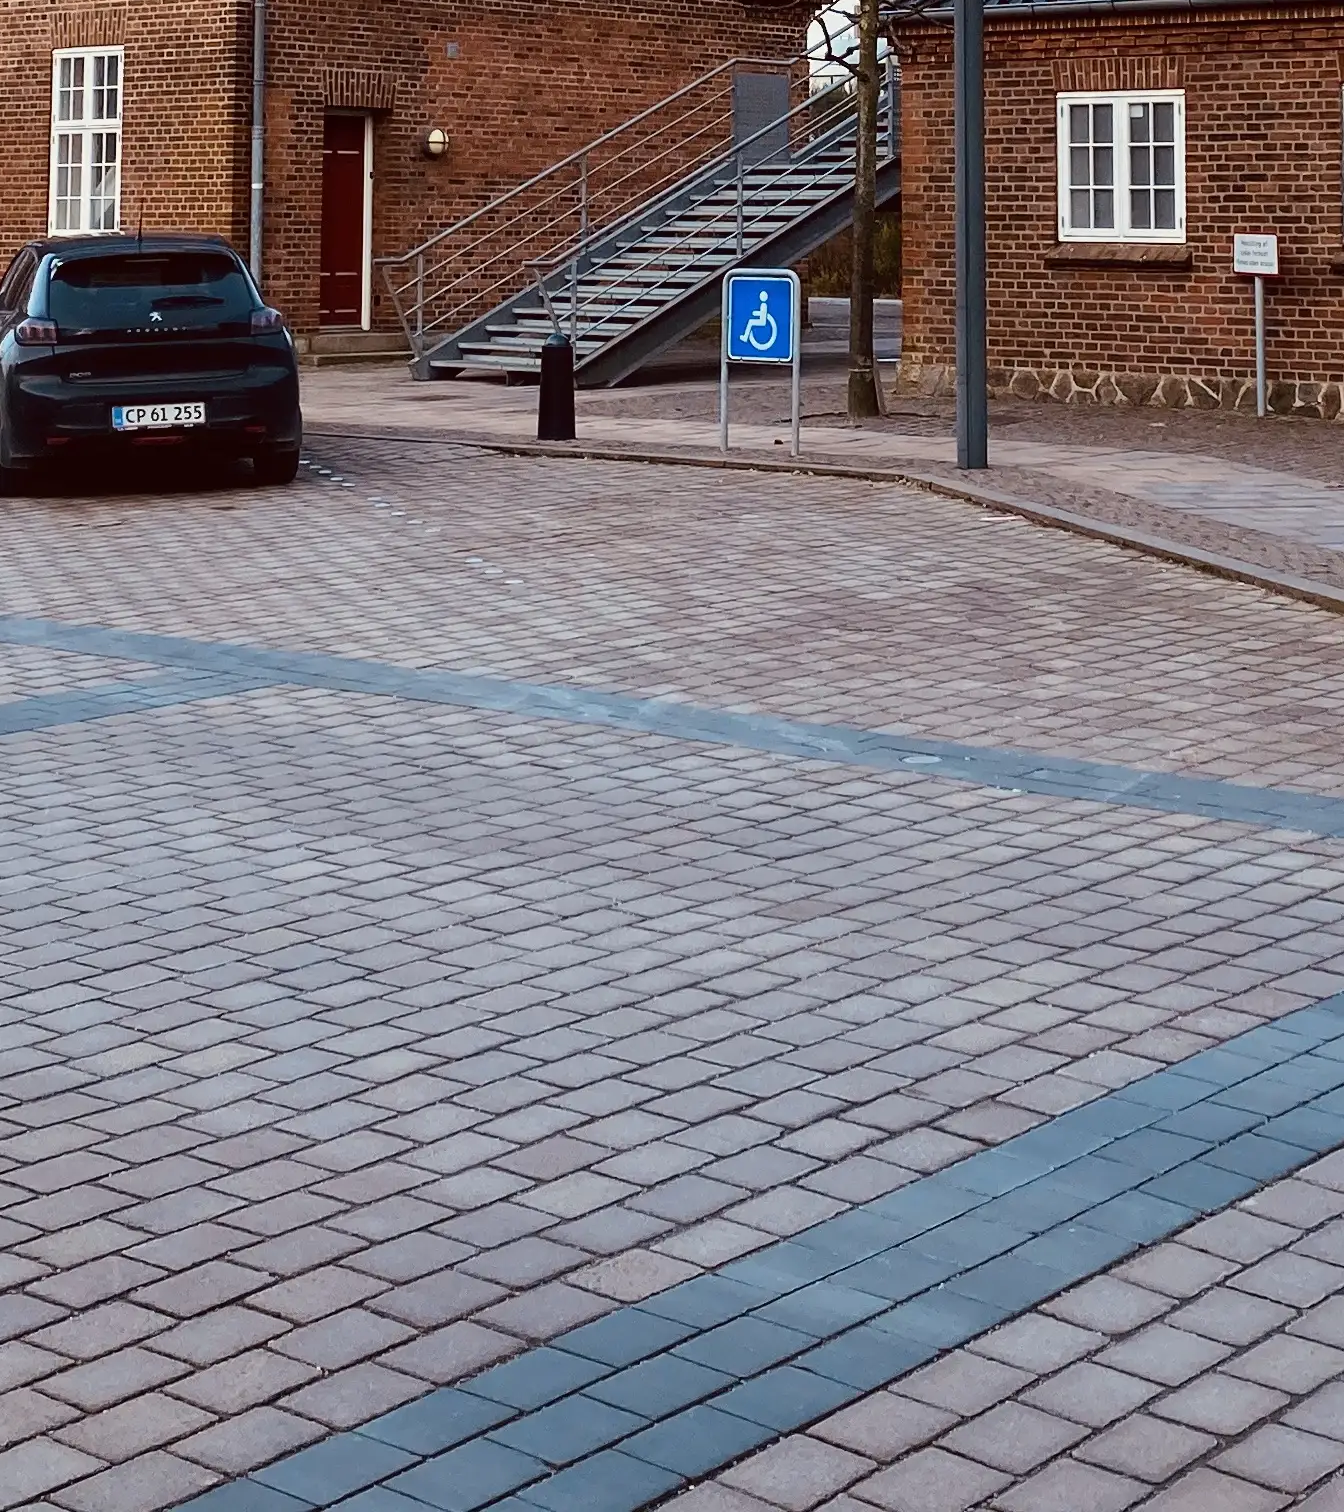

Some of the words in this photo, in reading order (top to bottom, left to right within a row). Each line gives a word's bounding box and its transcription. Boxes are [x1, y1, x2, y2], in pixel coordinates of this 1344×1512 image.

[126, 409, 146, 423] CP
[151, 407, 168, 421] 61
[173, 405, 202, 421] 255
